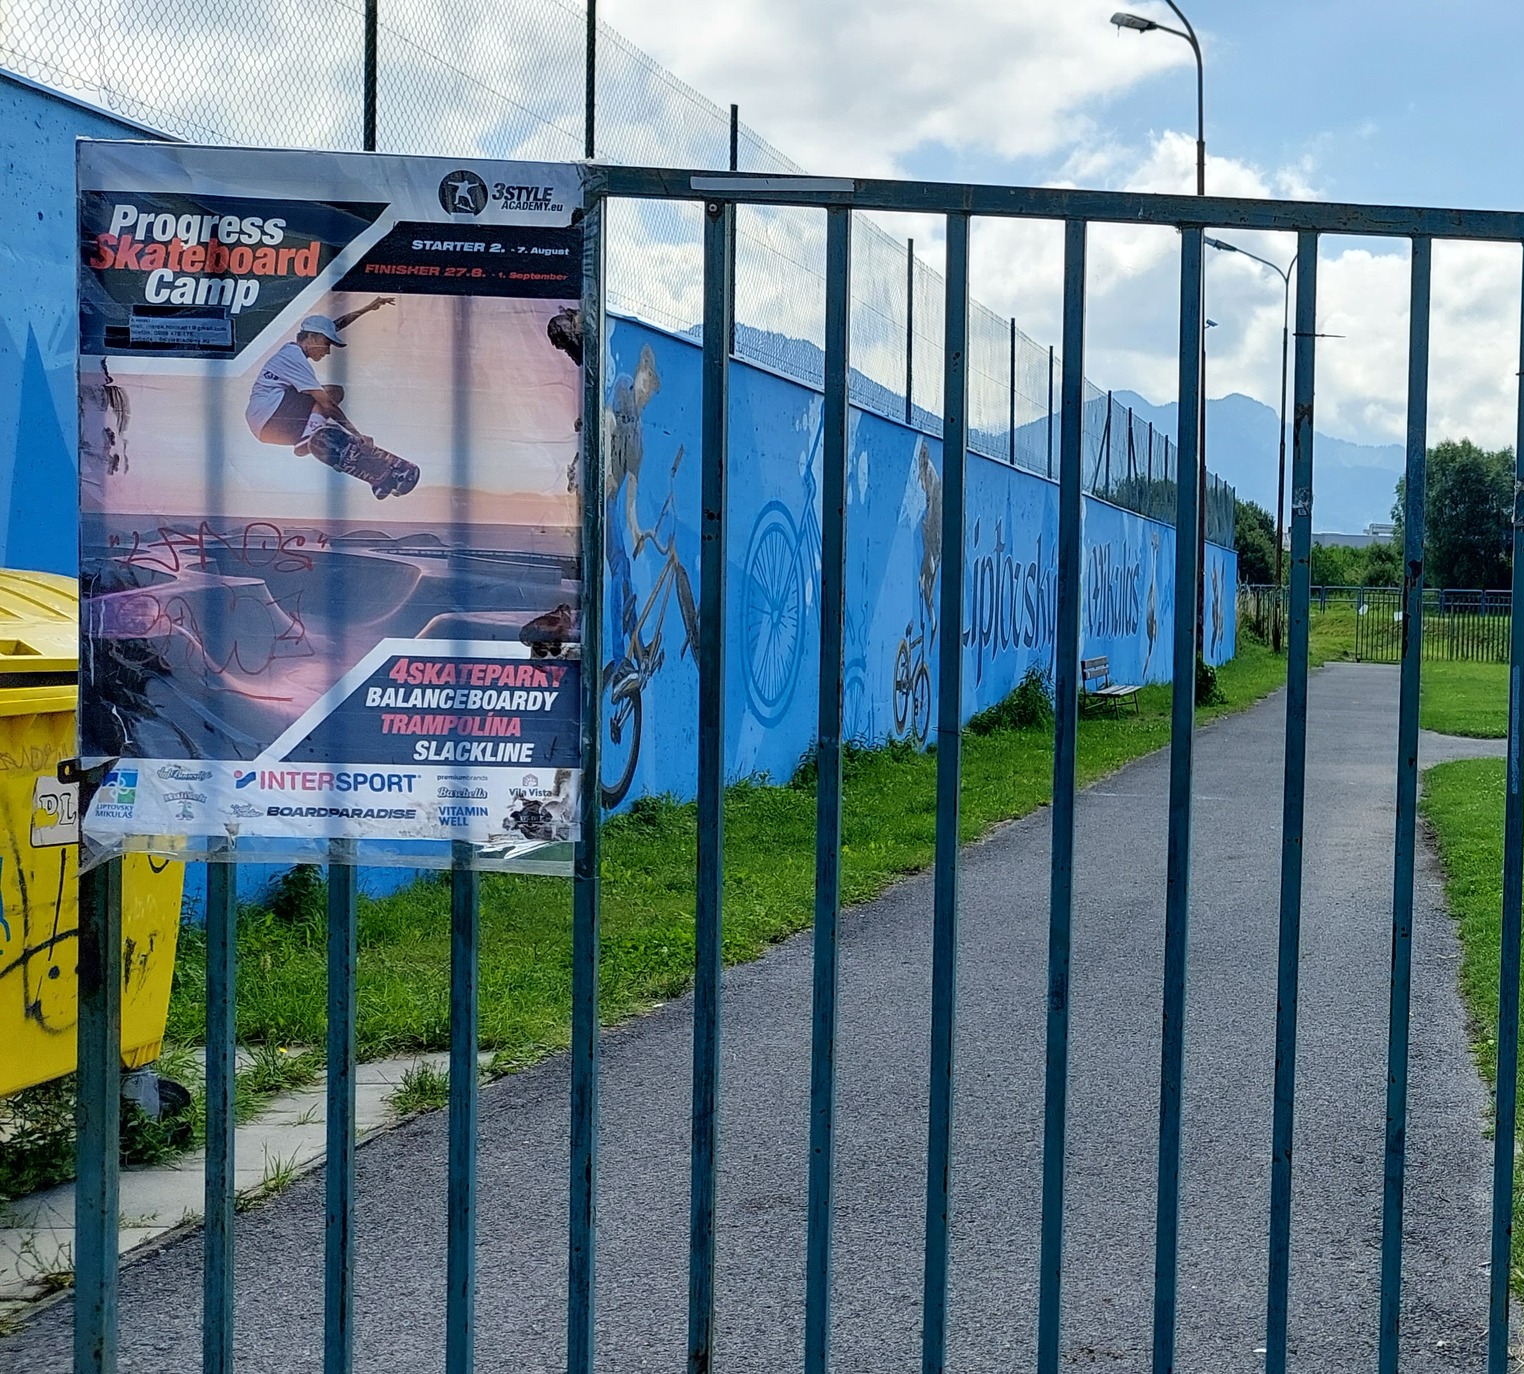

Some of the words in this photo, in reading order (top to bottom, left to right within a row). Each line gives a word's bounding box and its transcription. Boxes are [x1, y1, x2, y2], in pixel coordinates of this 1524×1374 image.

[491, 182, 554, 202] 3STYLE
[500, 200, 564, 212] ACADEMY.eu
[108, 204, 287, 250] Progress
[89, 232, 321, 277] Skateboard
[411, 239, 486, 253] STARTER
[489, 243, 506, 253] 2.
[517, 246, 528, 254] 7.
[530, 246, 570, 256] August
[365, 263, 440, 277] FINISHER
[508, 271, 569, 281] September
[144, 267, 260, 315] Camp
[389, 657, 568, 688] 4SKATEPARKY
[365, 687, 559, 712] BALANCEBOARDY
[381, 712, 521, 737] TRAMPOLÍNA
[413, 740, 535, 763] SLACKLINE
[259, 770, 417, 793] INTERSPORT
[508, 788, 527, 798] Vila
[529, 788, 553, 798] Vista
[267, 805, 417, 819] BOARDPARADISE
[438, 806, 489, 817] VITAMIN
[438, 816, 469, 827] WELL
